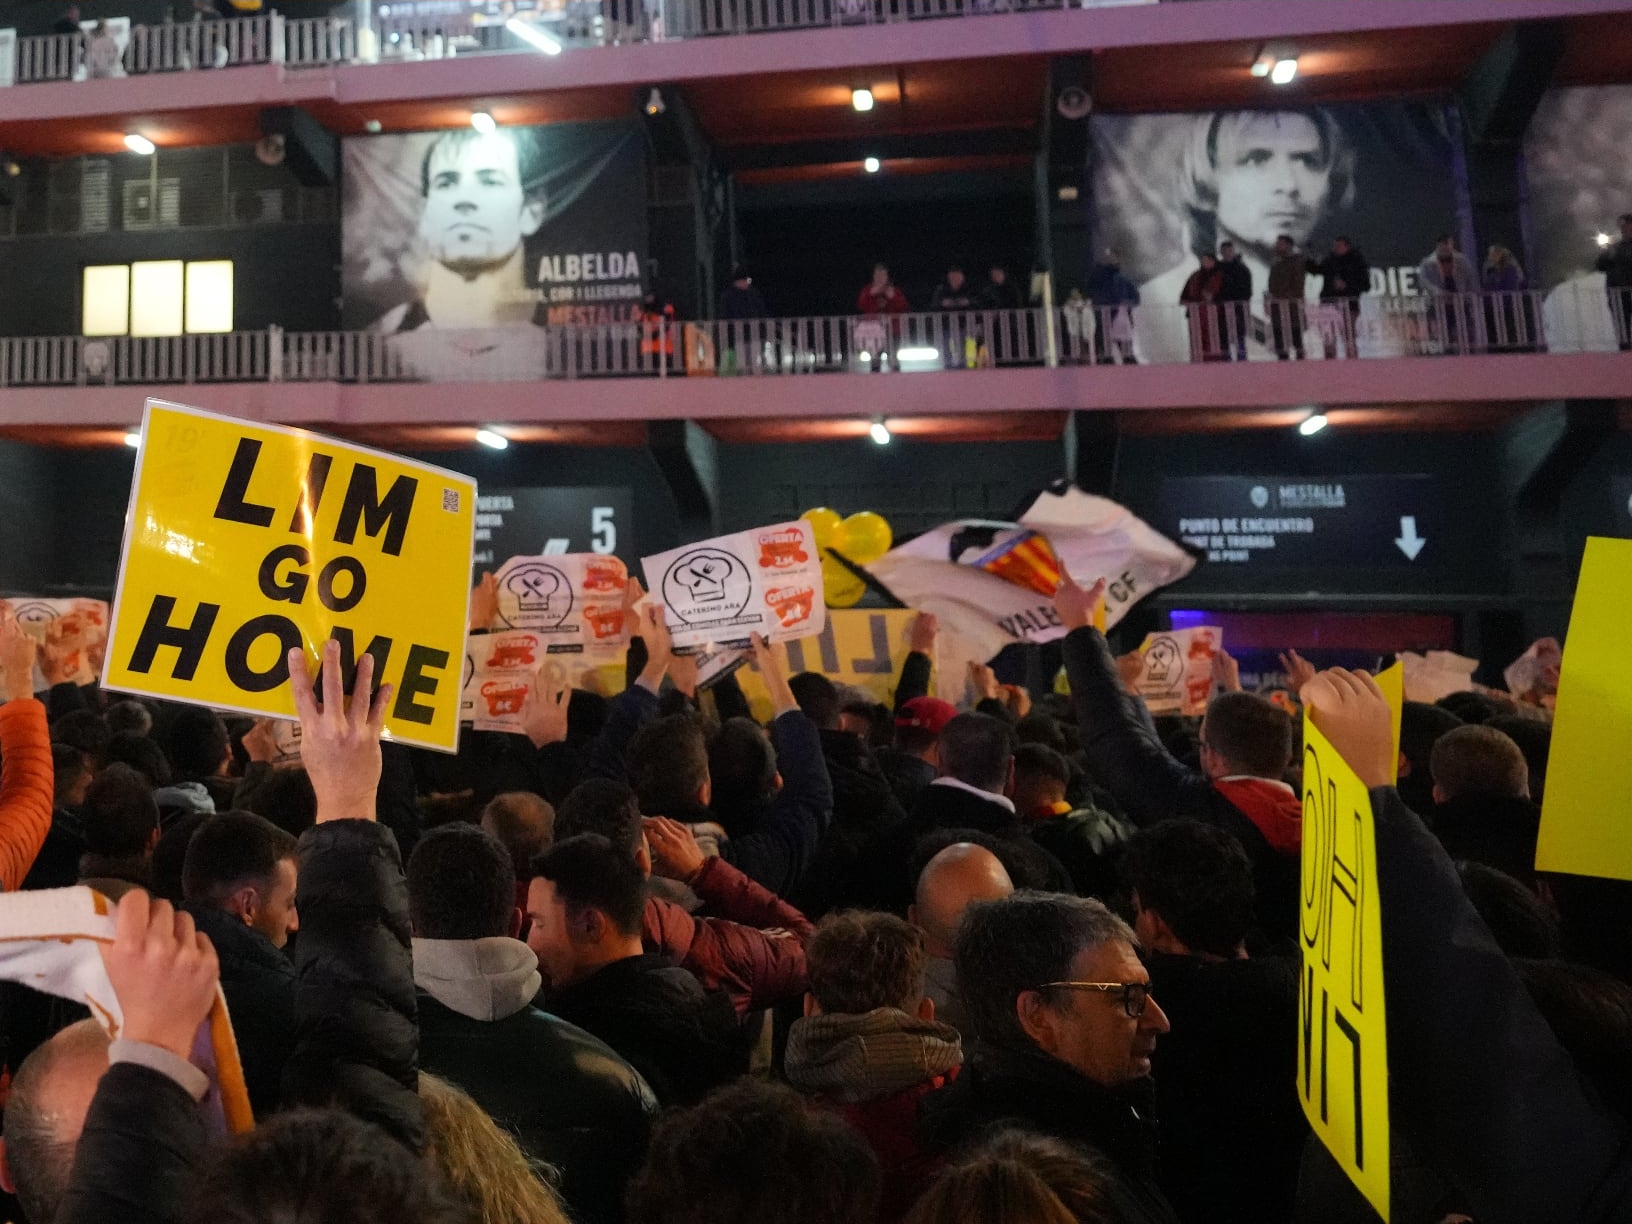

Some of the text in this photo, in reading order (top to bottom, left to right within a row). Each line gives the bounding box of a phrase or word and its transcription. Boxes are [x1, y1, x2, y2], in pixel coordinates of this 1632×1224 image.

[537, 252, 640, 283] ALBELDA
[214, 436, 419, 557] LIM
[591, 506, 617, 545] 5
[1179, 517, 1315, 533] PUNTO DE ENCUENTRO
[258, 543, 367, 613] GO
[681, 604, 722, 617] CATERING
[127, 594, 451, 725] HOME
